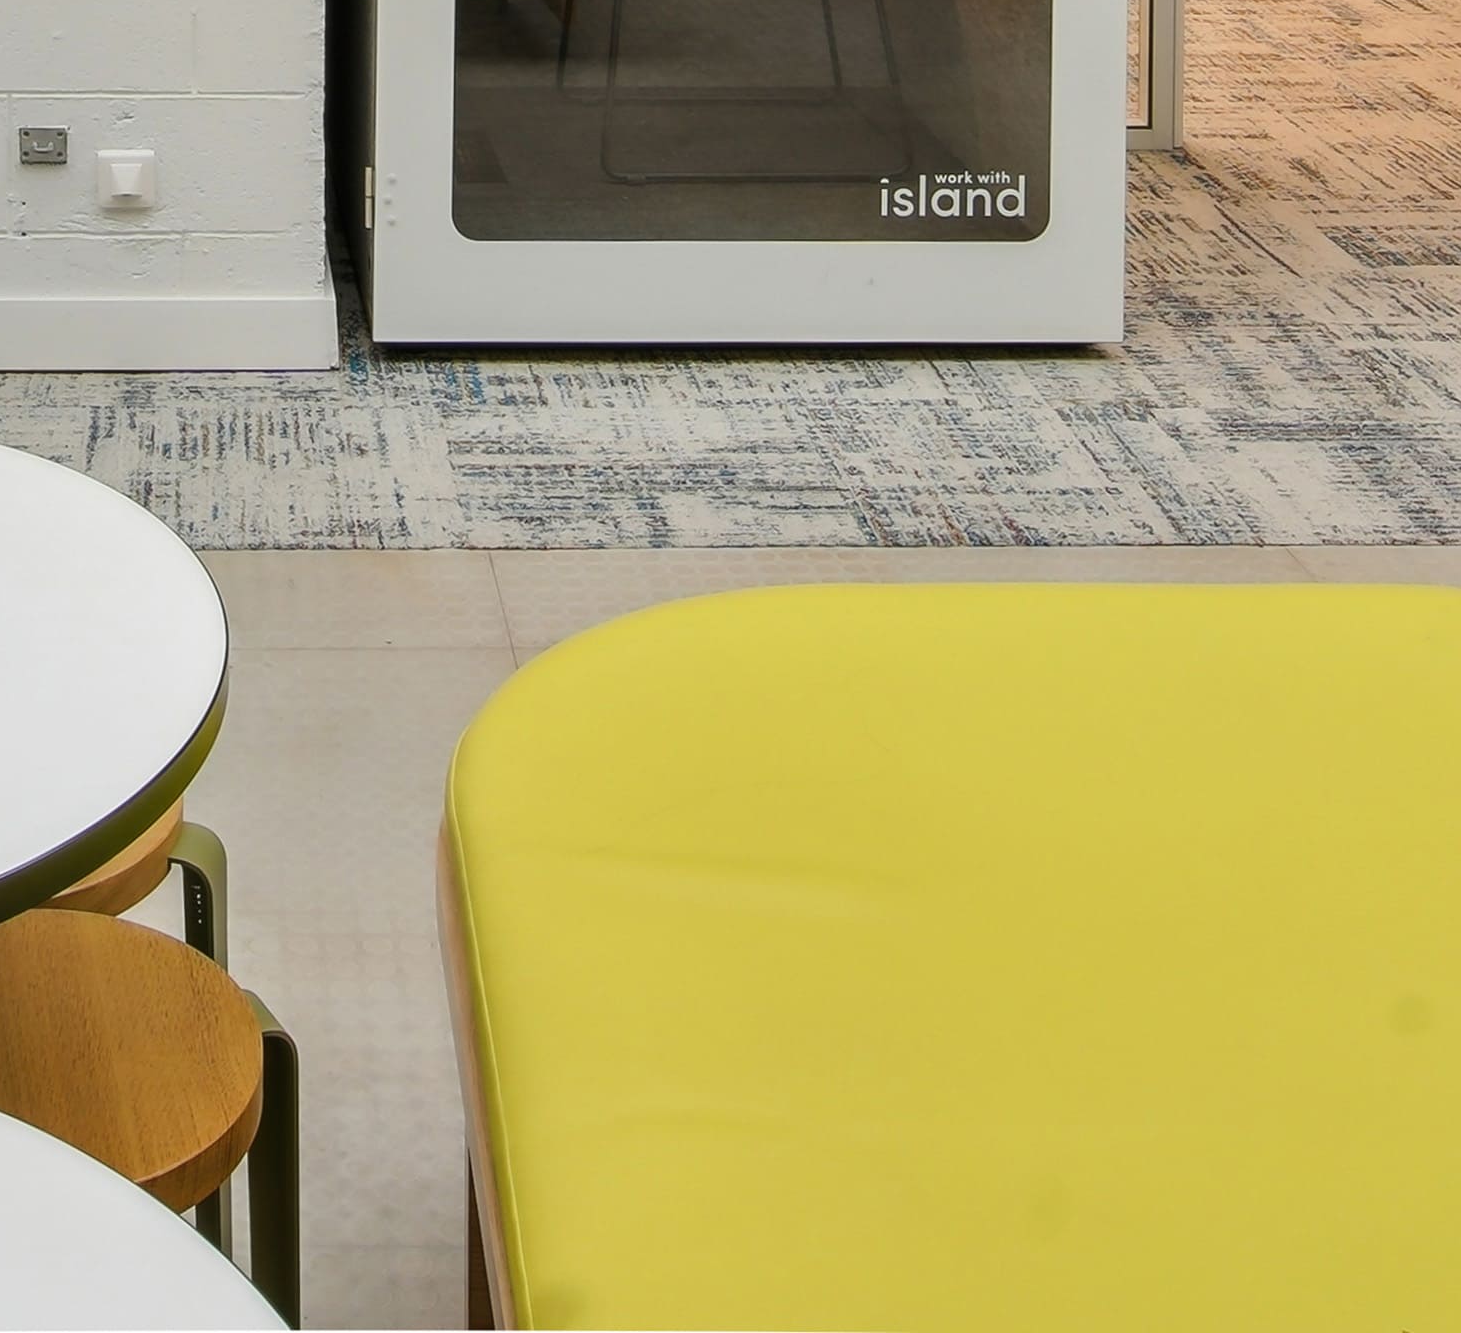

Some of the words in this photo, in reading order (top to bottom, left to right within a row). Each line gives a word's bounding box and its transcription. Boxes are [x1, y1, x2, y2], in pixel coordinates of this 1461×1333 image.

[934, 172, 973, 184] work
[977, 171, 1011, 184] with
[879, 174, 1027, 218] island
